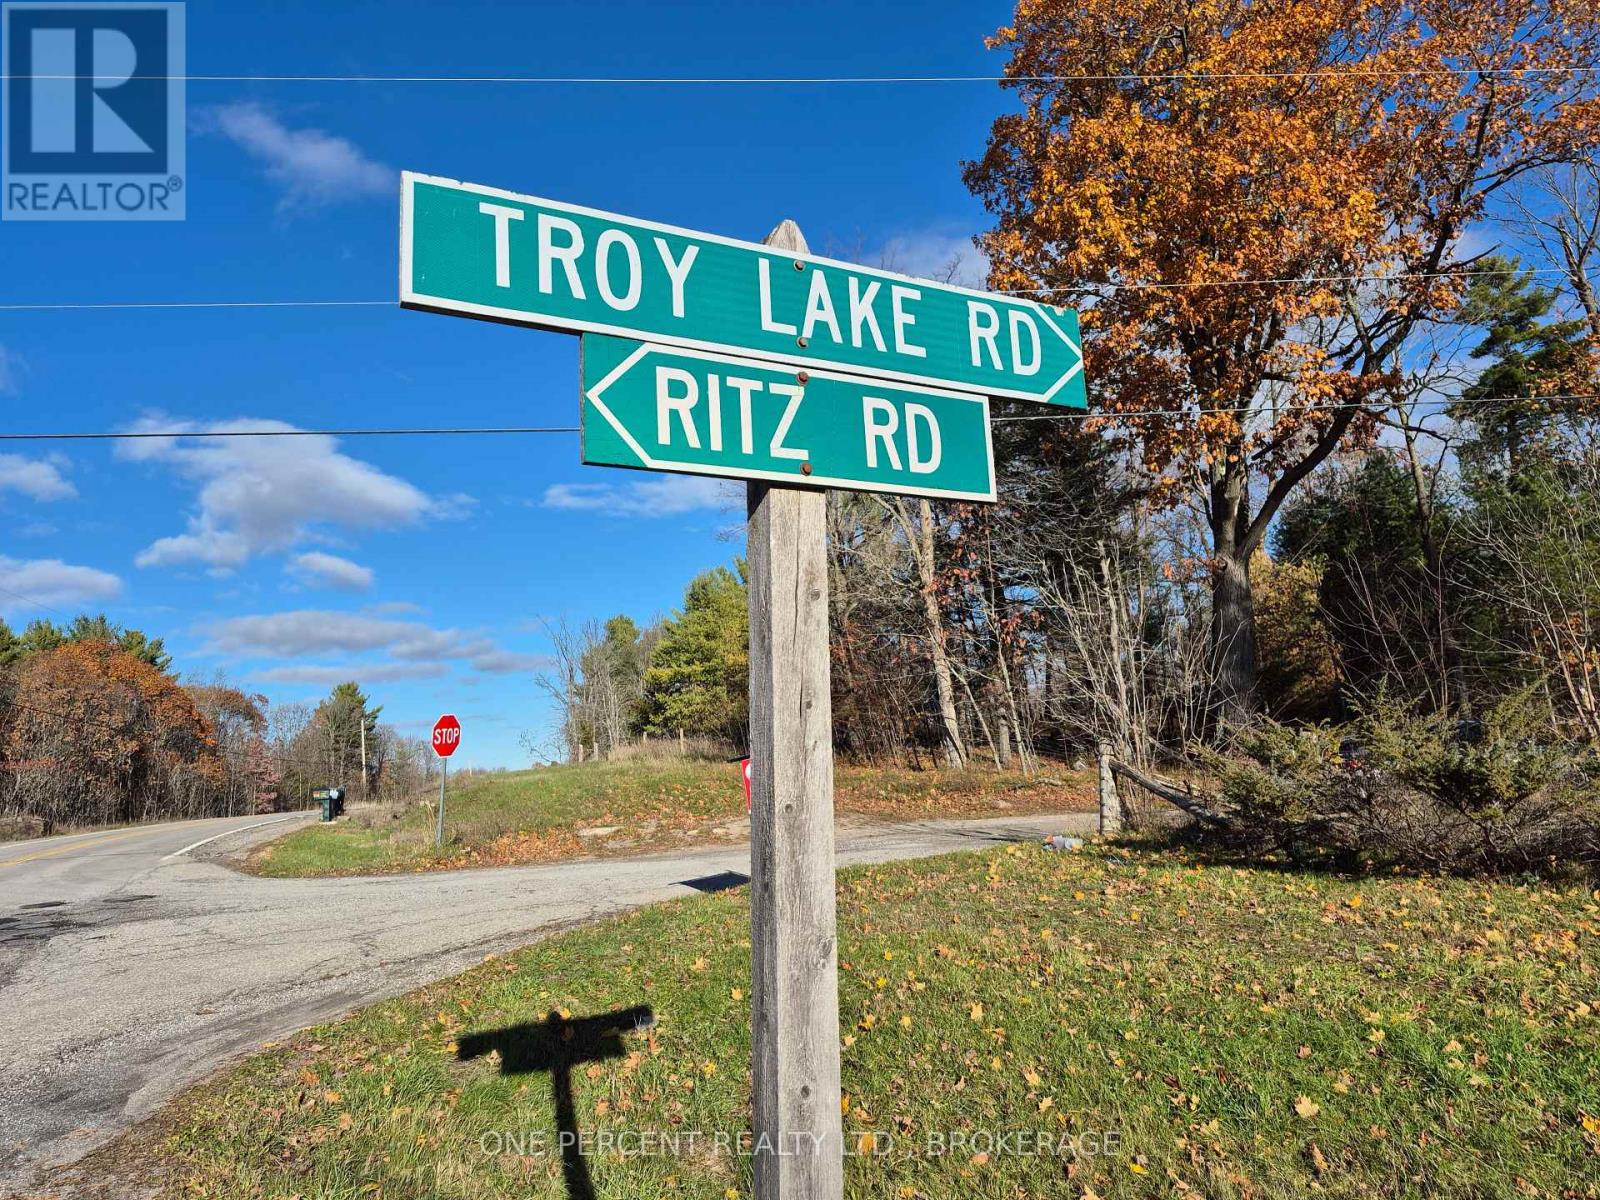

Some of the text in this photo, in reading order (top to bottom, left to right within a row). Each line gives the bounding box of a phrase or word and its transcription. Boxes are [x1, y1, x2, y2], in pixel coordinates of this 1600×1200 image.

[479, 202, 1043, 377] TROY LAKE RD
[655, 366, 943, 475] RITZ RD
[434, 728, 460, 745] STOP
